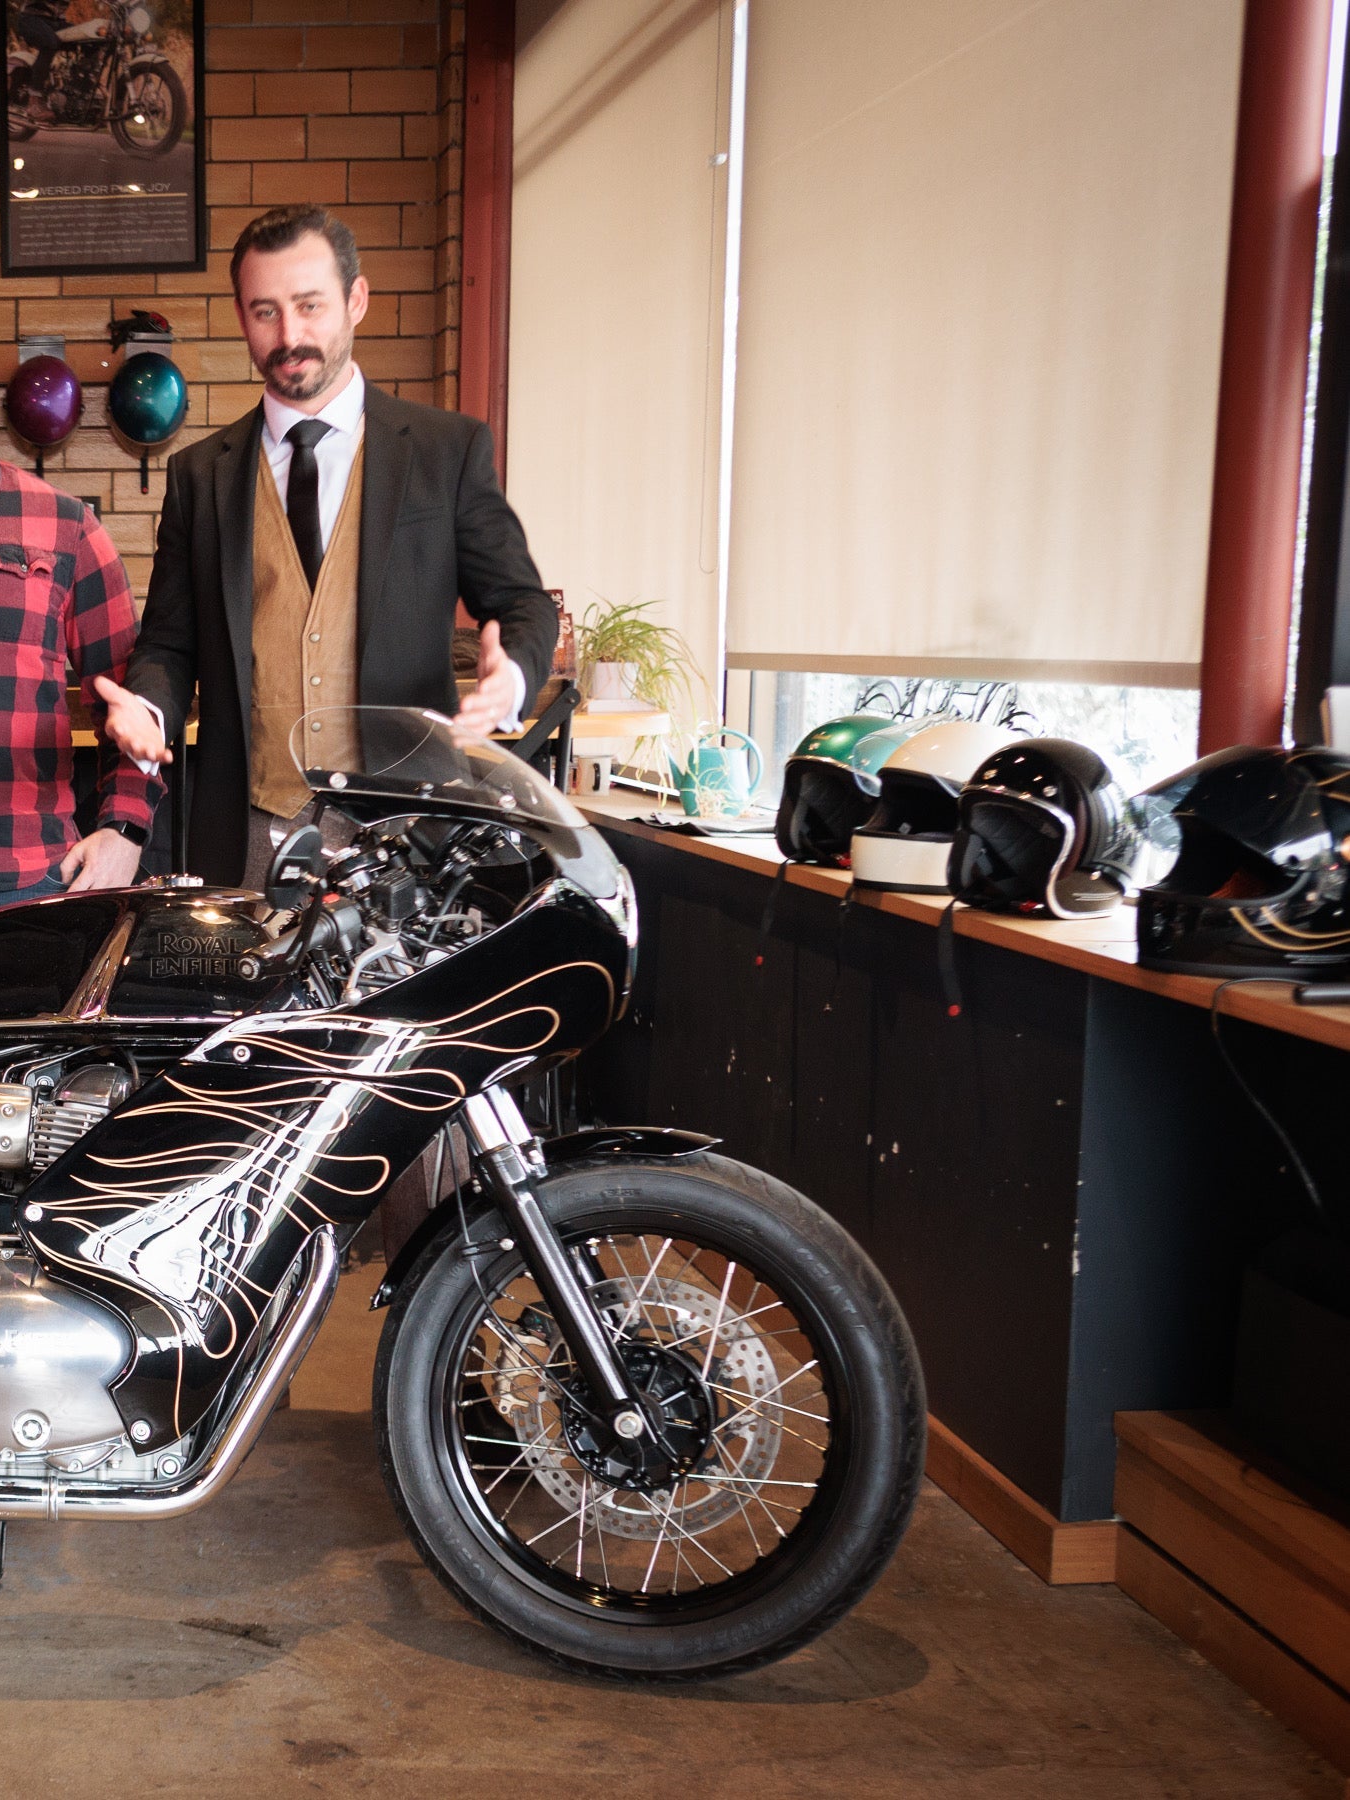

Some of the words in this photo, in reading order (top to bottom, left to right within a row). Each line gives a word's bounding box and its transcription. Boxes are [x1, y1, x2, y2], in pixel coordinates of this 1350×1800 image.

[20, 186, 81, 196] PWERED
[83, 185, 108, 195] FOR
[147, 183, 170, 192] JOY
[158, 932, 243, 956] ROYAL
[150, 957, 244, 979] ENFIEL
